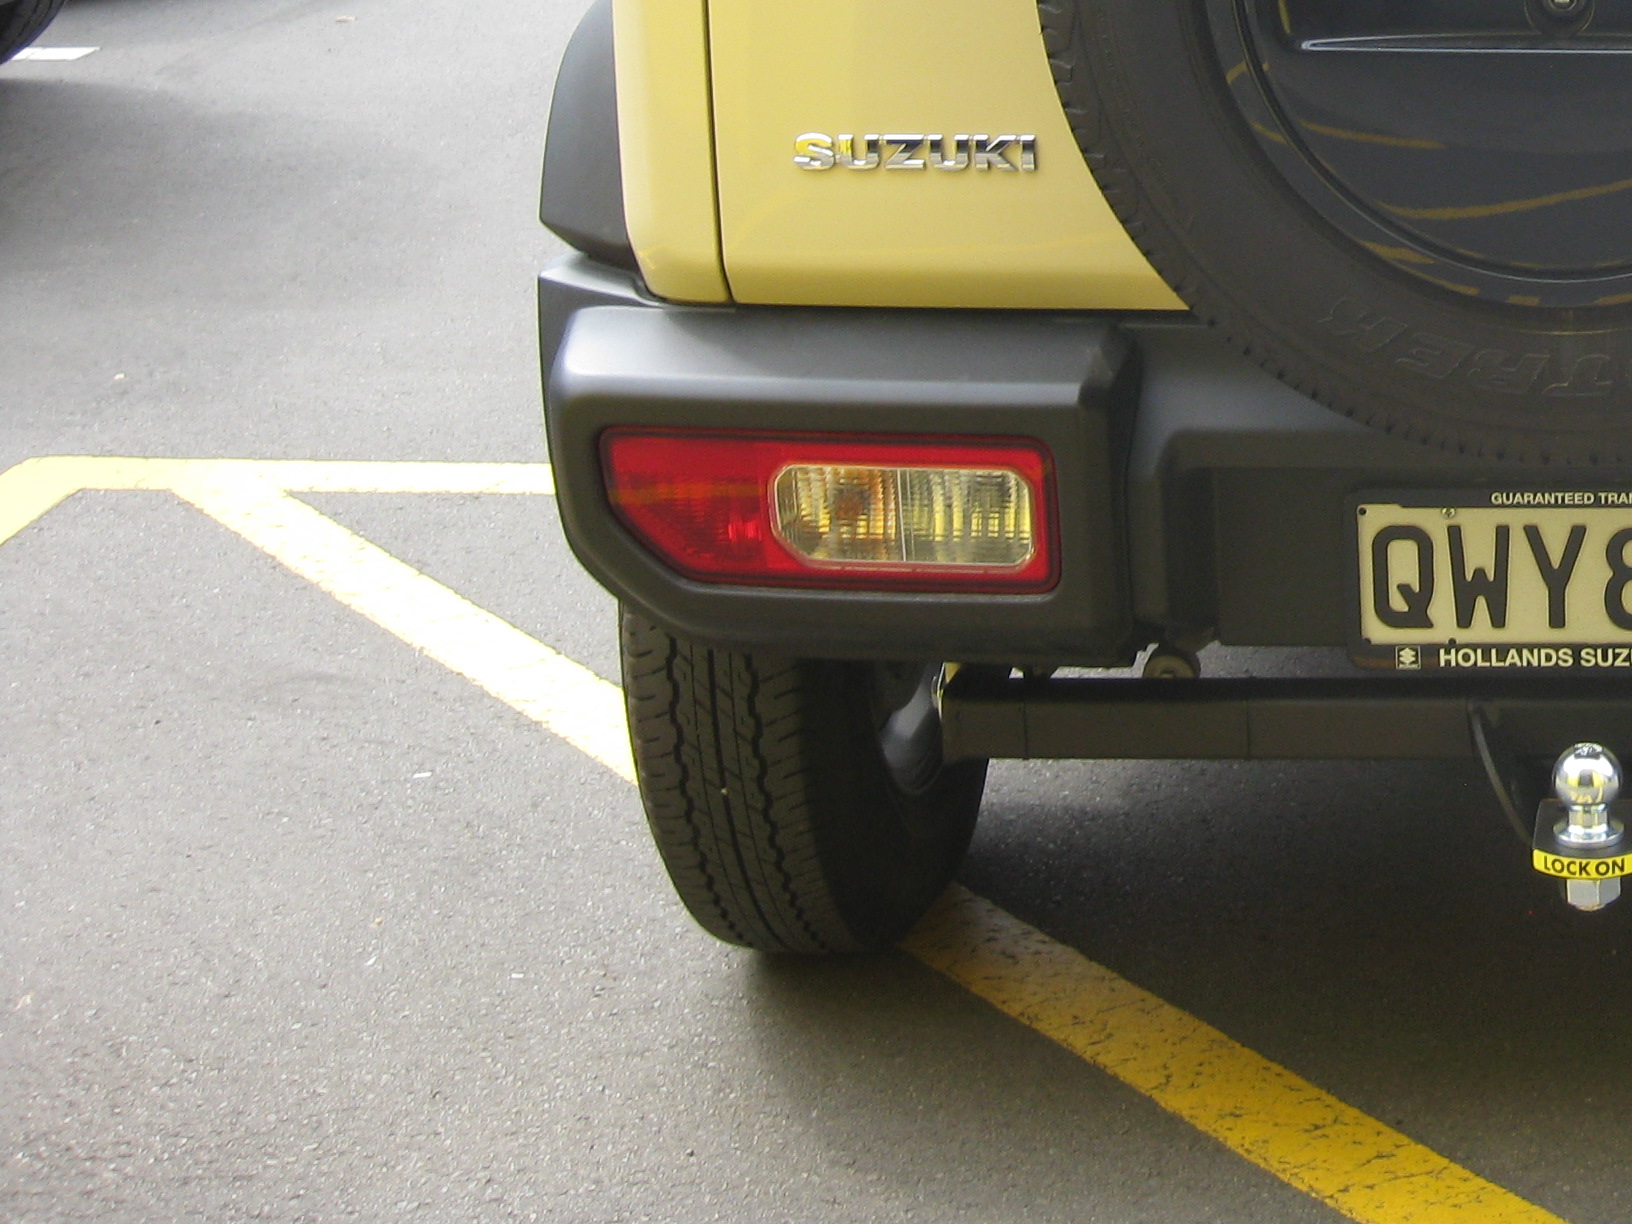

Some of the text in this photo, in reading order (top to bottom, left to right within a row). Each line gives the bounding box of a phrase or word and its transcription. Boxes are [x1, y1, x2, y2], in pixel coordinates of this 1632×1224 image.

[793, 132, 1037, 171] SUZUKI
[1490, 492, 1595, 505] GUARANTEED
[1439, 647, 1574, 668] HOLLANDS
[1543, 855, 1625, 876] LOCK ON
